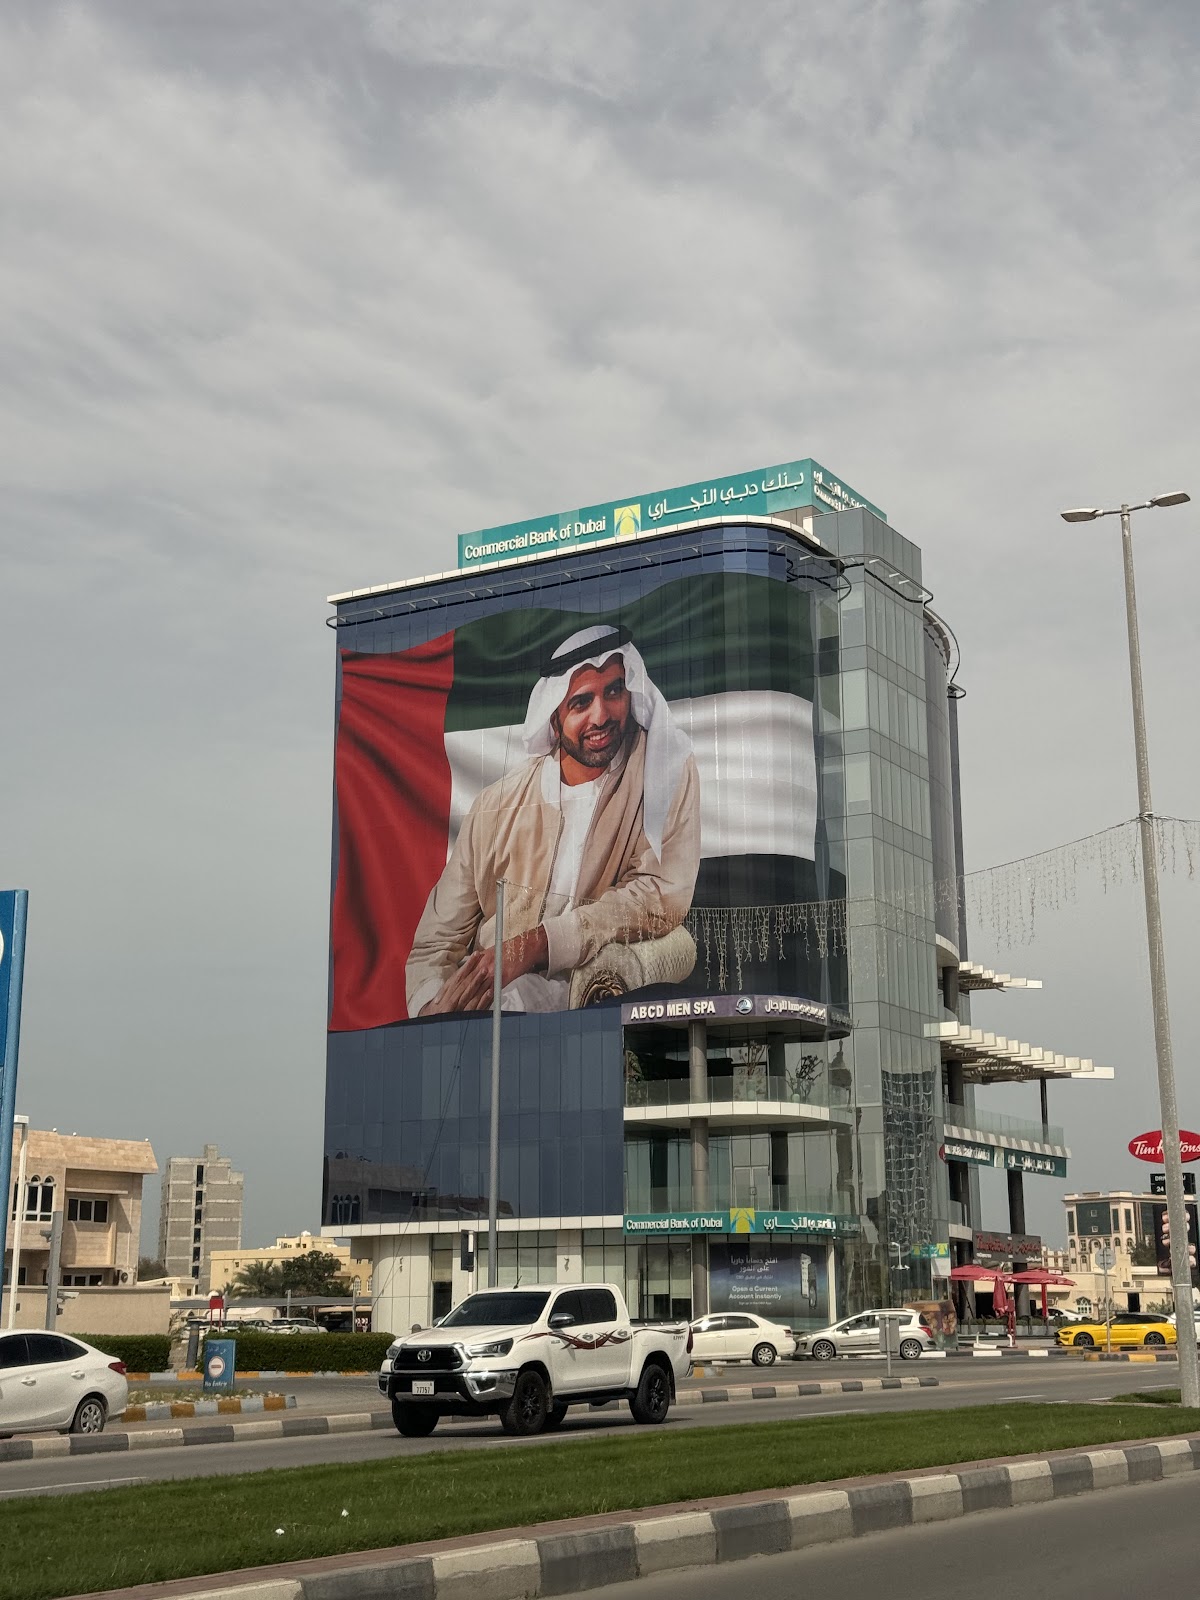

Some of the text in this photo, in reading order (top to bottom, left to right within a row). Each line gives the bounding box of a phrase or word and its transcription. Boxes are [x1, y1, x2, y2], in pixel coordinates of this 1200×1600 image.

[648, 471, 804, 521] بنك دبي التجاري
[464, 516, 606, 559] Commercial Bank of Dubai
[630, 1000, 716, 1019] ABCD MEN SPA
[764, 1000, 787, 1013] للرجال
[1133, 1141, 1155, 1155] Tim
[626, 1217, 723, 1230] Commercial Bank of Dubai
[763, 1216, 808, 1230] التجاري
[732, 1285, 748, 1293] Open
